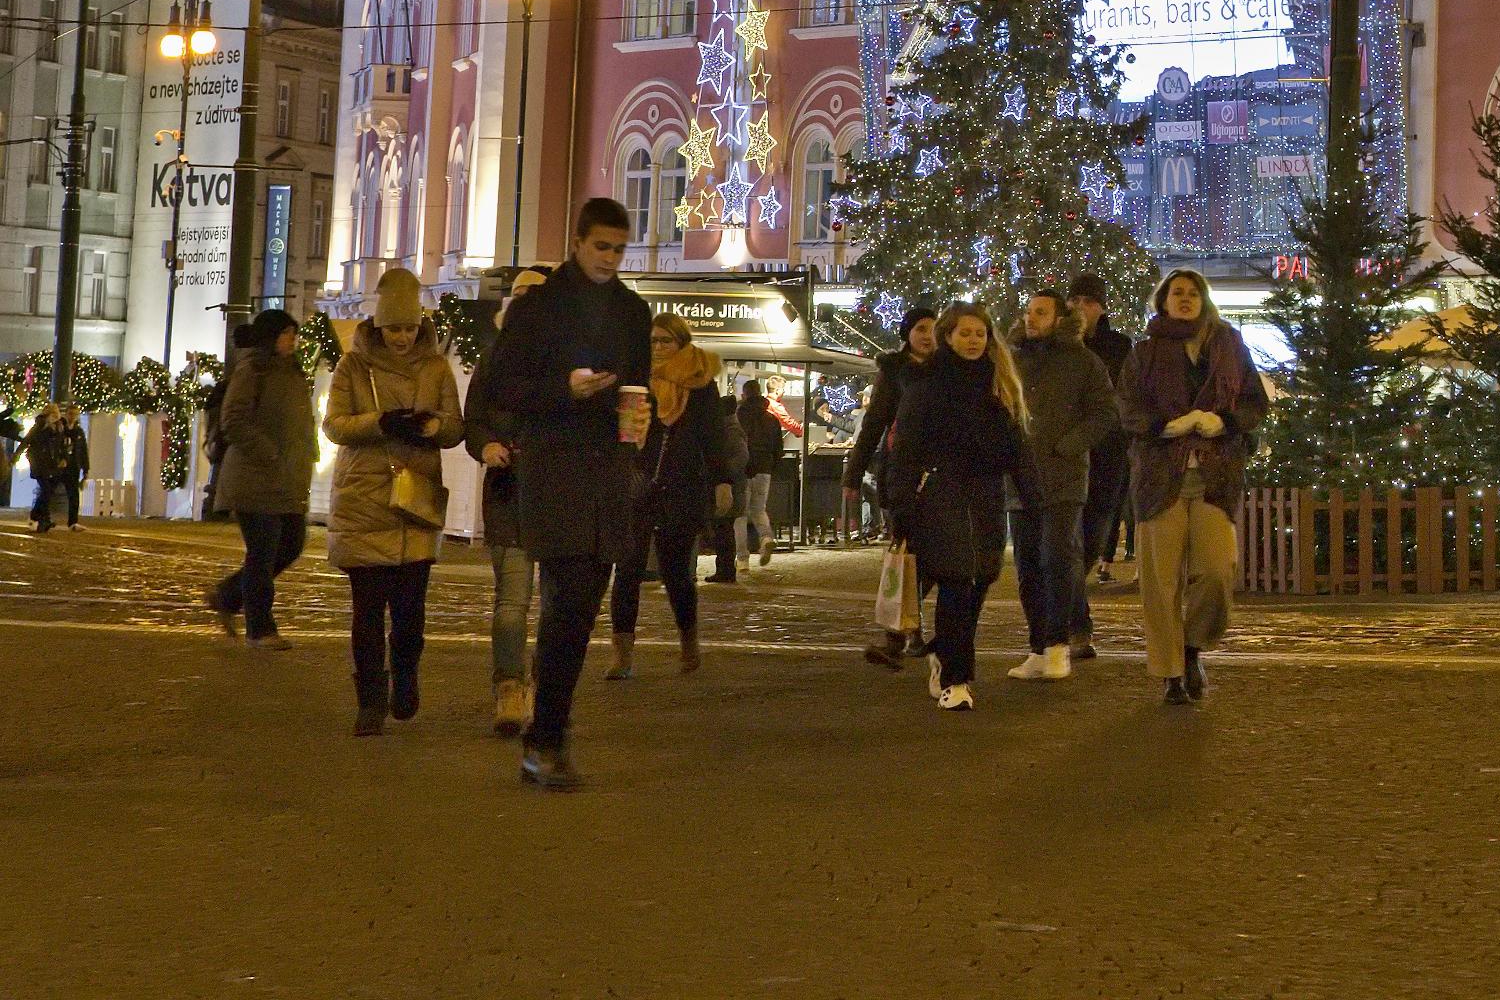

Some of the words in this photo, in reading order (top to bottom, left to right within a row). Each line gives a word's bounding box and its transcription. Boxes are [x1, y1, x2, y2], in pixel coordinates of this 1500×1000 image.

[1074, 0, 1156, 30] aurants,
[227, 49, 241, 64] se
[149, 85, 157, 99] a
[1162, 77, 1185, 95] C&A
[195, 111, 202, 125] z
[1158, 125, 1197, 138] orsay
[1260, 159, 1309, 174] LINDEX
[151, 163, 232, 208] Kotva
[274, 194, 283, 235] MACAO
[208, 247, 227, 262] dům
[185, 272, 205, 286] roku
[207, 270, 226, 285] 1975
[673, 302, 714, 318] Krále
[700, 320, 724, 328] George
